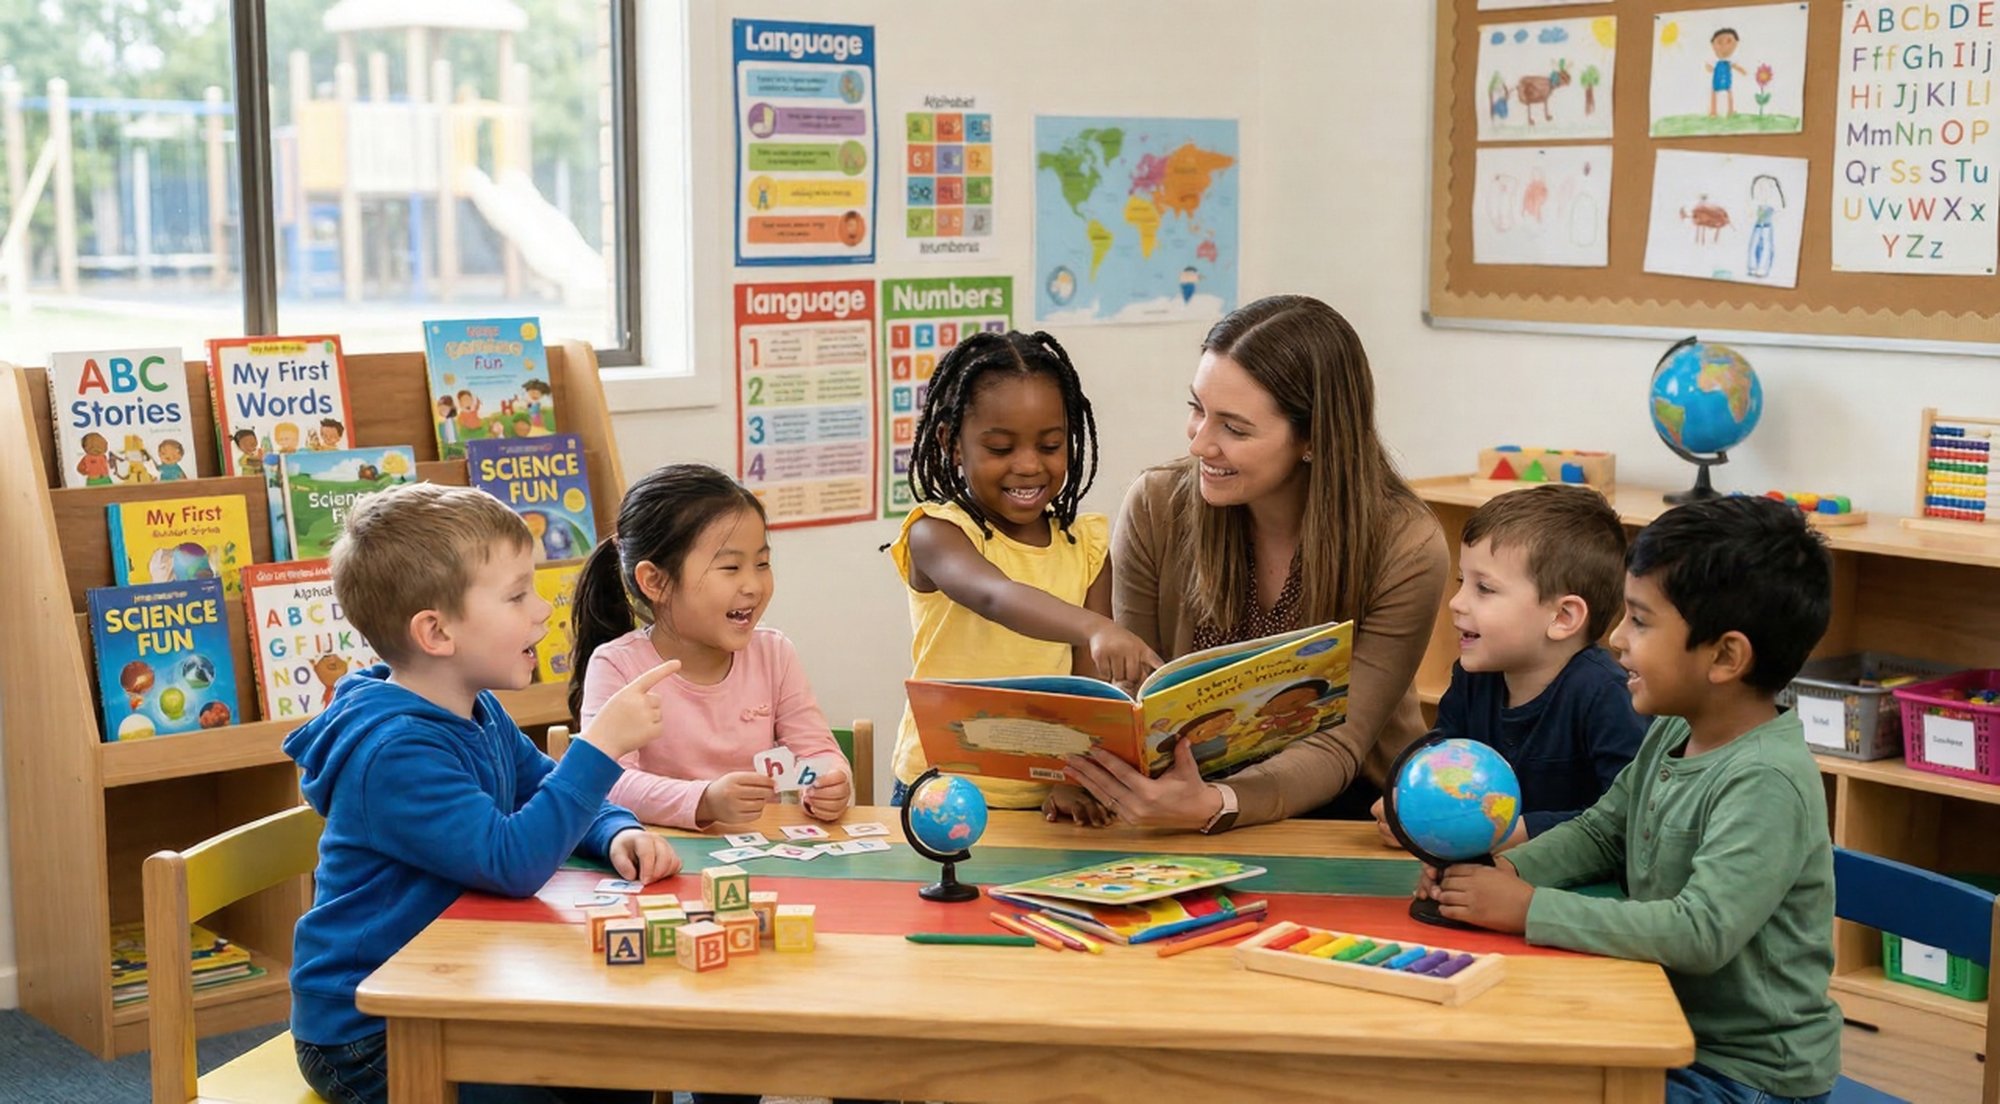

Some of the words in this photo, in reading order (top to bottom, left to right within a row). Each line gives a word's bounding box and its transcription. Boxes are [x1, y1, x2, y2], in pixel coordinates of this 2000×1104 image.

[746, 25, 863, 61] Language
[746, 287, 866, 320] language
[892, 282, 1004, 311] Numbers
[749, 338, 759, 367] 1
[78, 356, 168, 395] ABC
[233, 363, 269, 389] My
[278, 361, 330, 382] First
[236, 388, 334, 418] Words
[748, 376, 764, 405] 2
[71, 396, 182, 428] Stories
[749, 415, 765, 445] 3
[481, 453, 580, 482] SCIENCE
[747, 452, 766, 481] 4
[308, 490, 356, 508] Scien
[509, 479, 559, 504] FUN
[146, 509, 176, 528] My
[182, 505, 223, 523] First
[105, 599, 218, 633] SCIENCE
[138, 628, 195, 656] FUN
[722, 882, 743, 905] A
[614, 935, 637, 958] A
[702, 940, 721, 964] B
[730, 927, 751, 950] C
